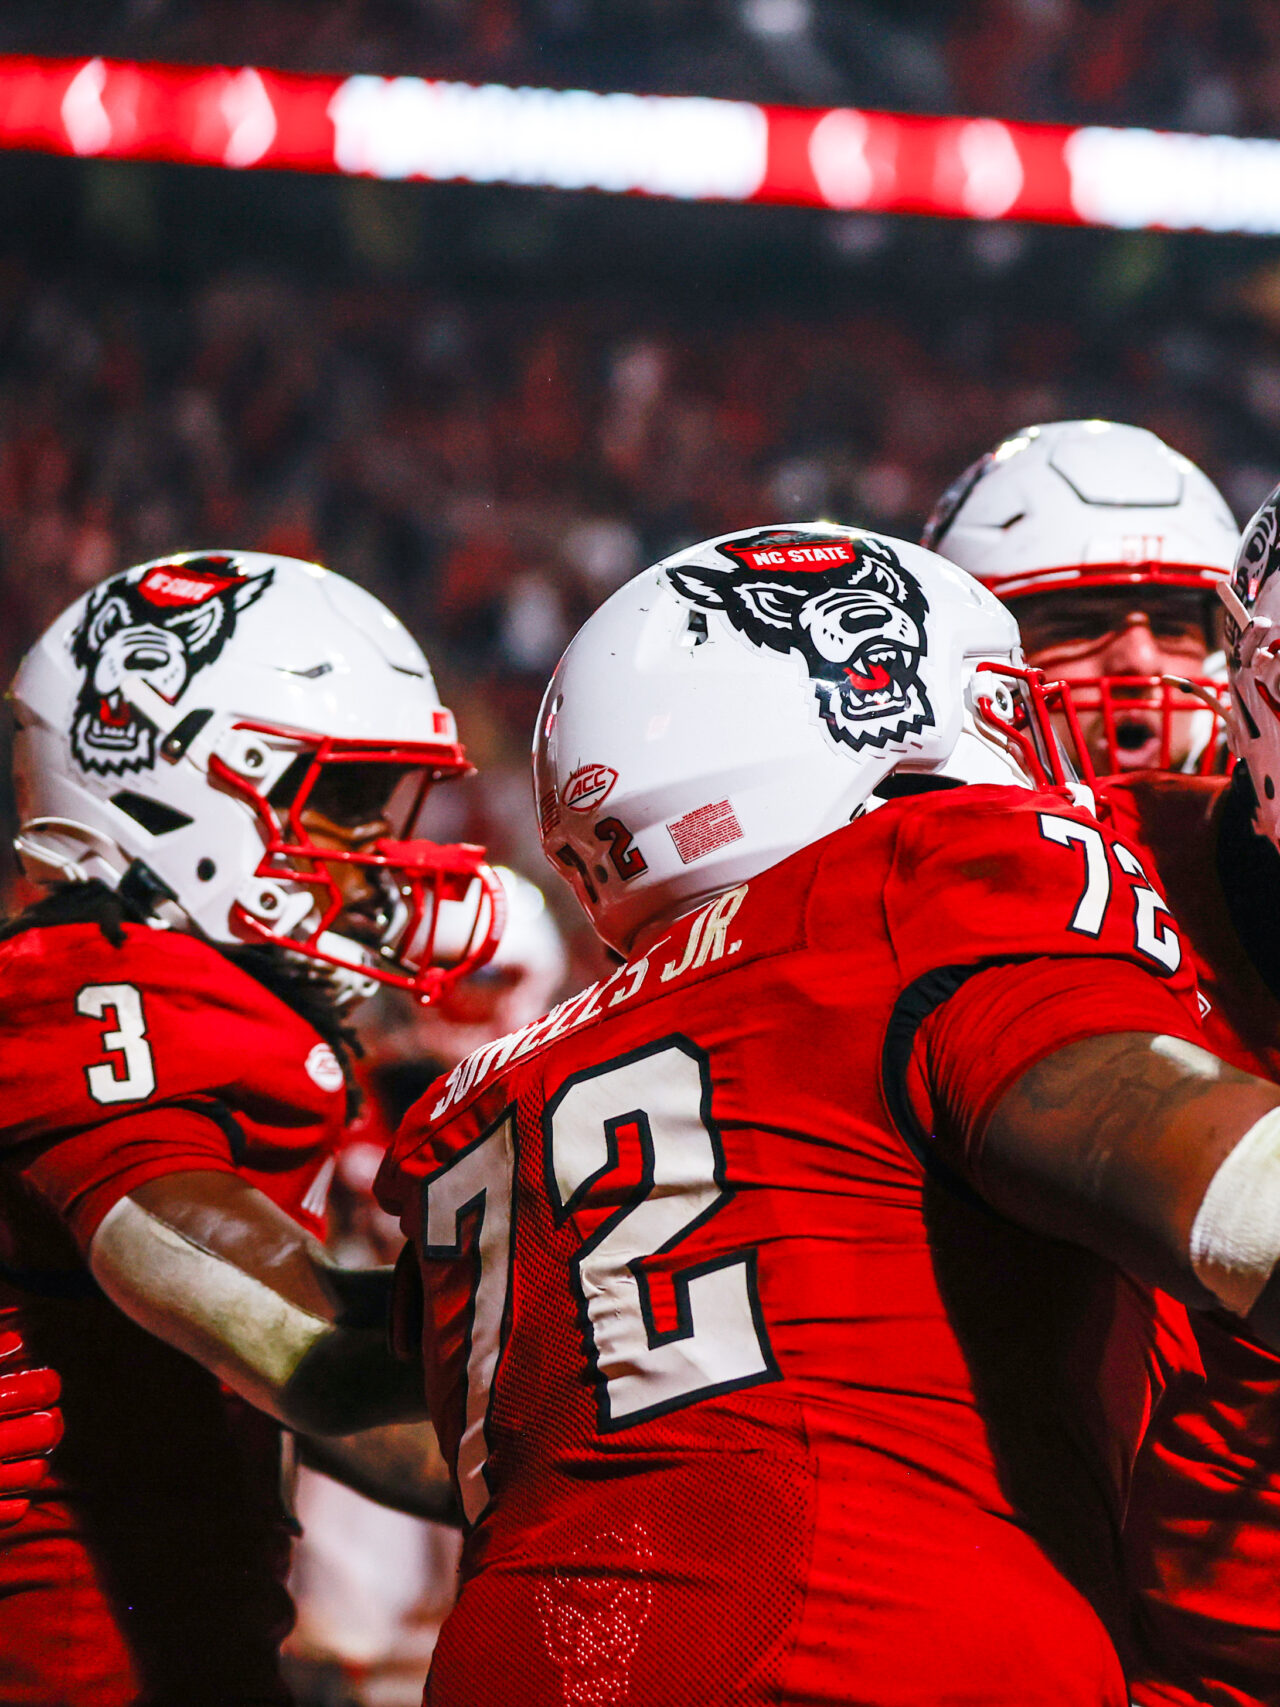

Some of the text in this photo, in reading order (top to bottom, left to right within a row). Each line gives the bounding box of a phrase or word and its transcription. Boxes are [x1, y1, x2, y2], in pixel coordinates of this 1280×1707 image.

[752, 546, 850, 566] NC STATE
[567, 766, 609, 803] ACC
[555, 816, 649, 903] 72
[1036, 812, 1182, 980] 72
[660, 883, 749, 983] JR.
[76, 981, 158, 1103] 3
[423, 1030, 784, 1529] 72
